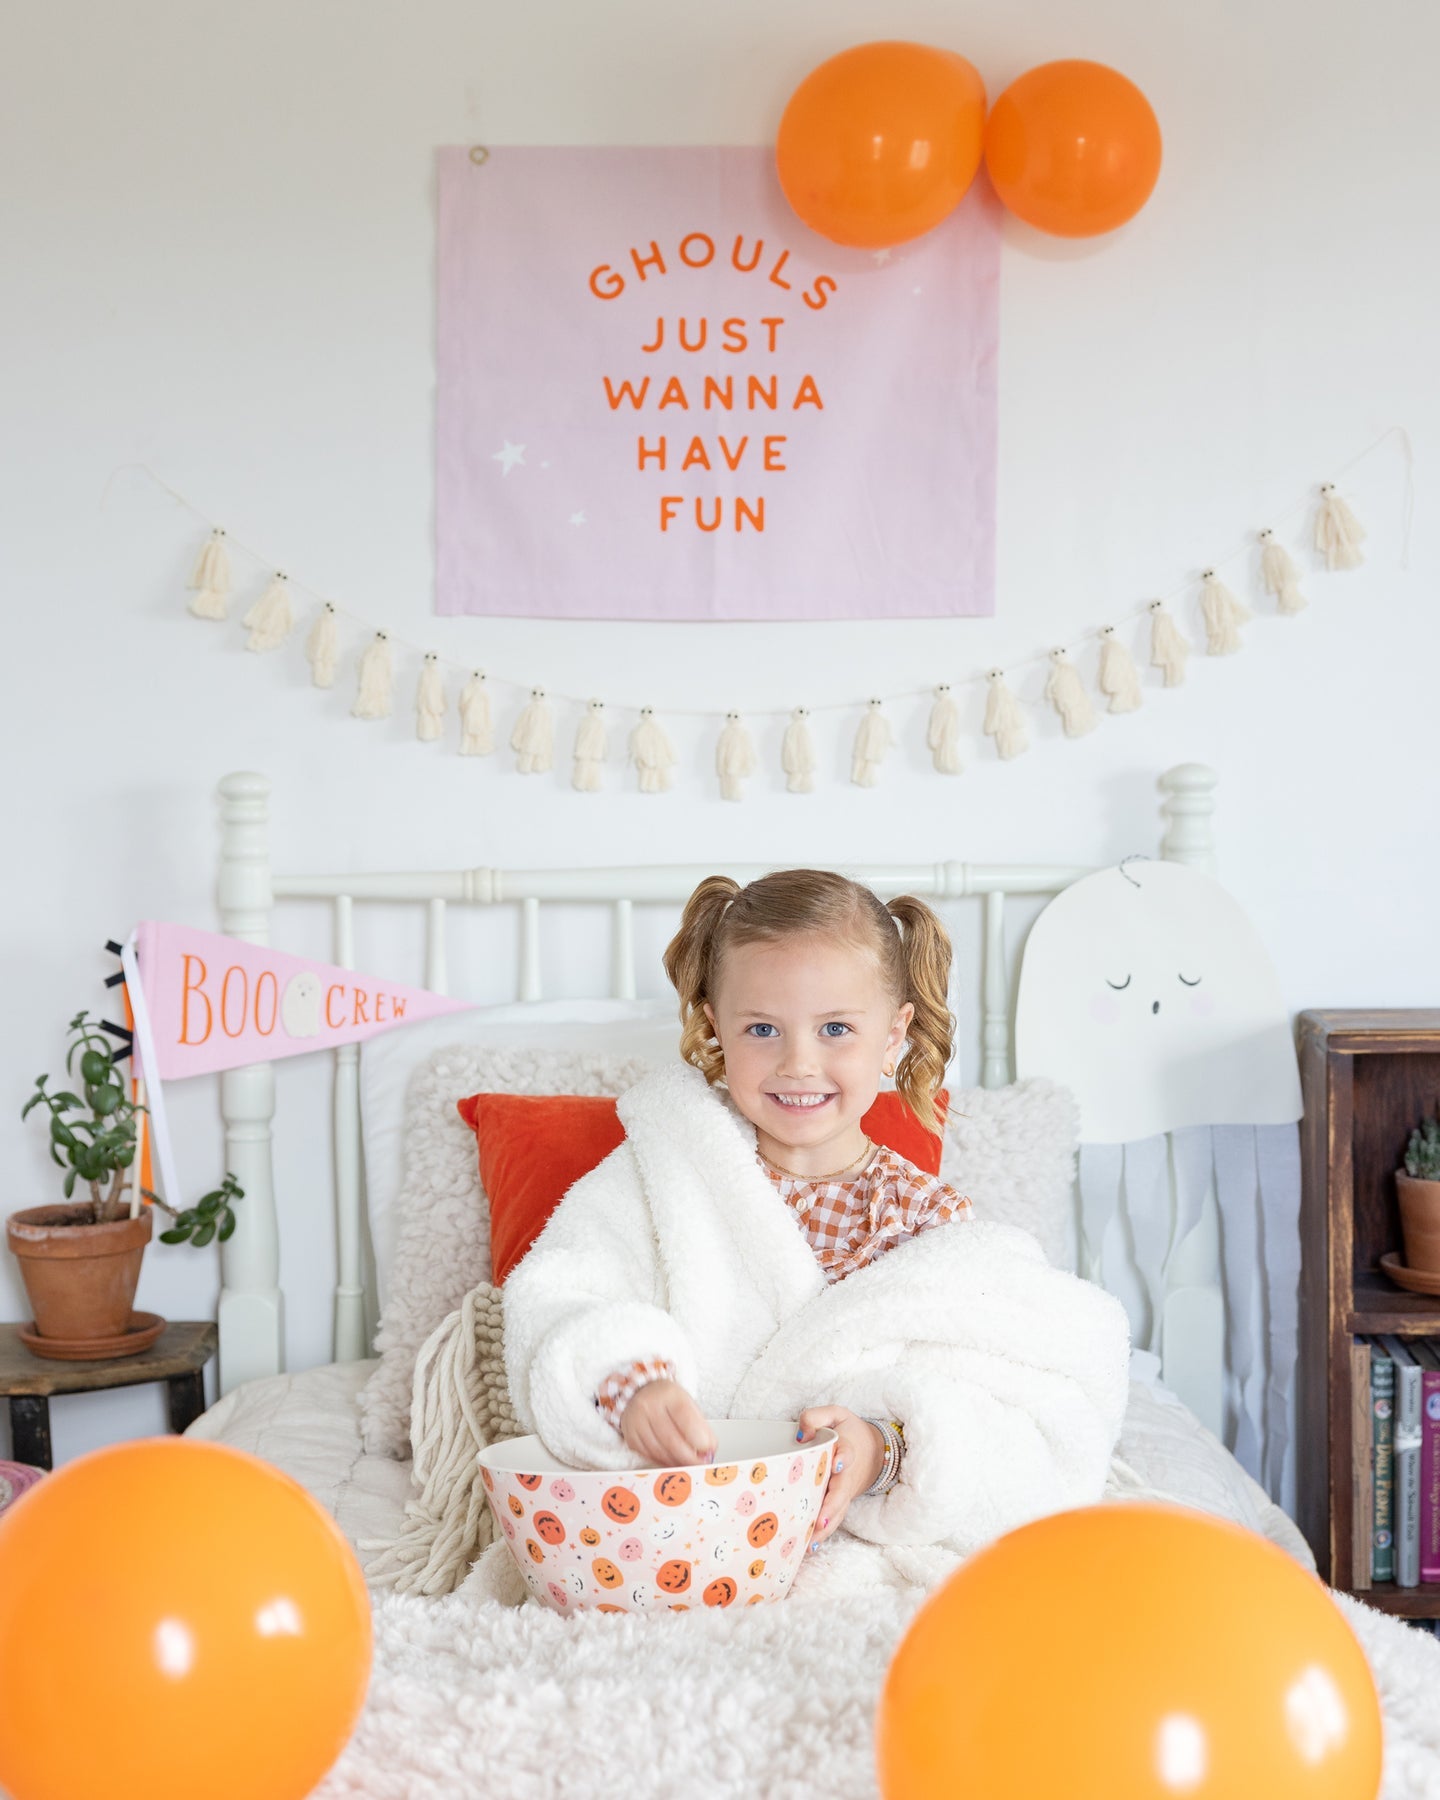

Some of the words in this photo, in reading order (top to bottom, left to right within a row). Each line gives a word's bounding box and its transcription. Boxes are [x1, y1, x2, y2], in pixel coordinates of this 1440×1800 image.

[588, 231, 838, 311] GHOULS
[641, 316, 785, 354] JUST
[602, 374, 824, 411] WANNA
[637, 435, 787, 472] HAVE
[660, 495, 765, 533] FUN
[177, 953, 278, 1046] BOO
[325, 984, 407, 1029] CREW
